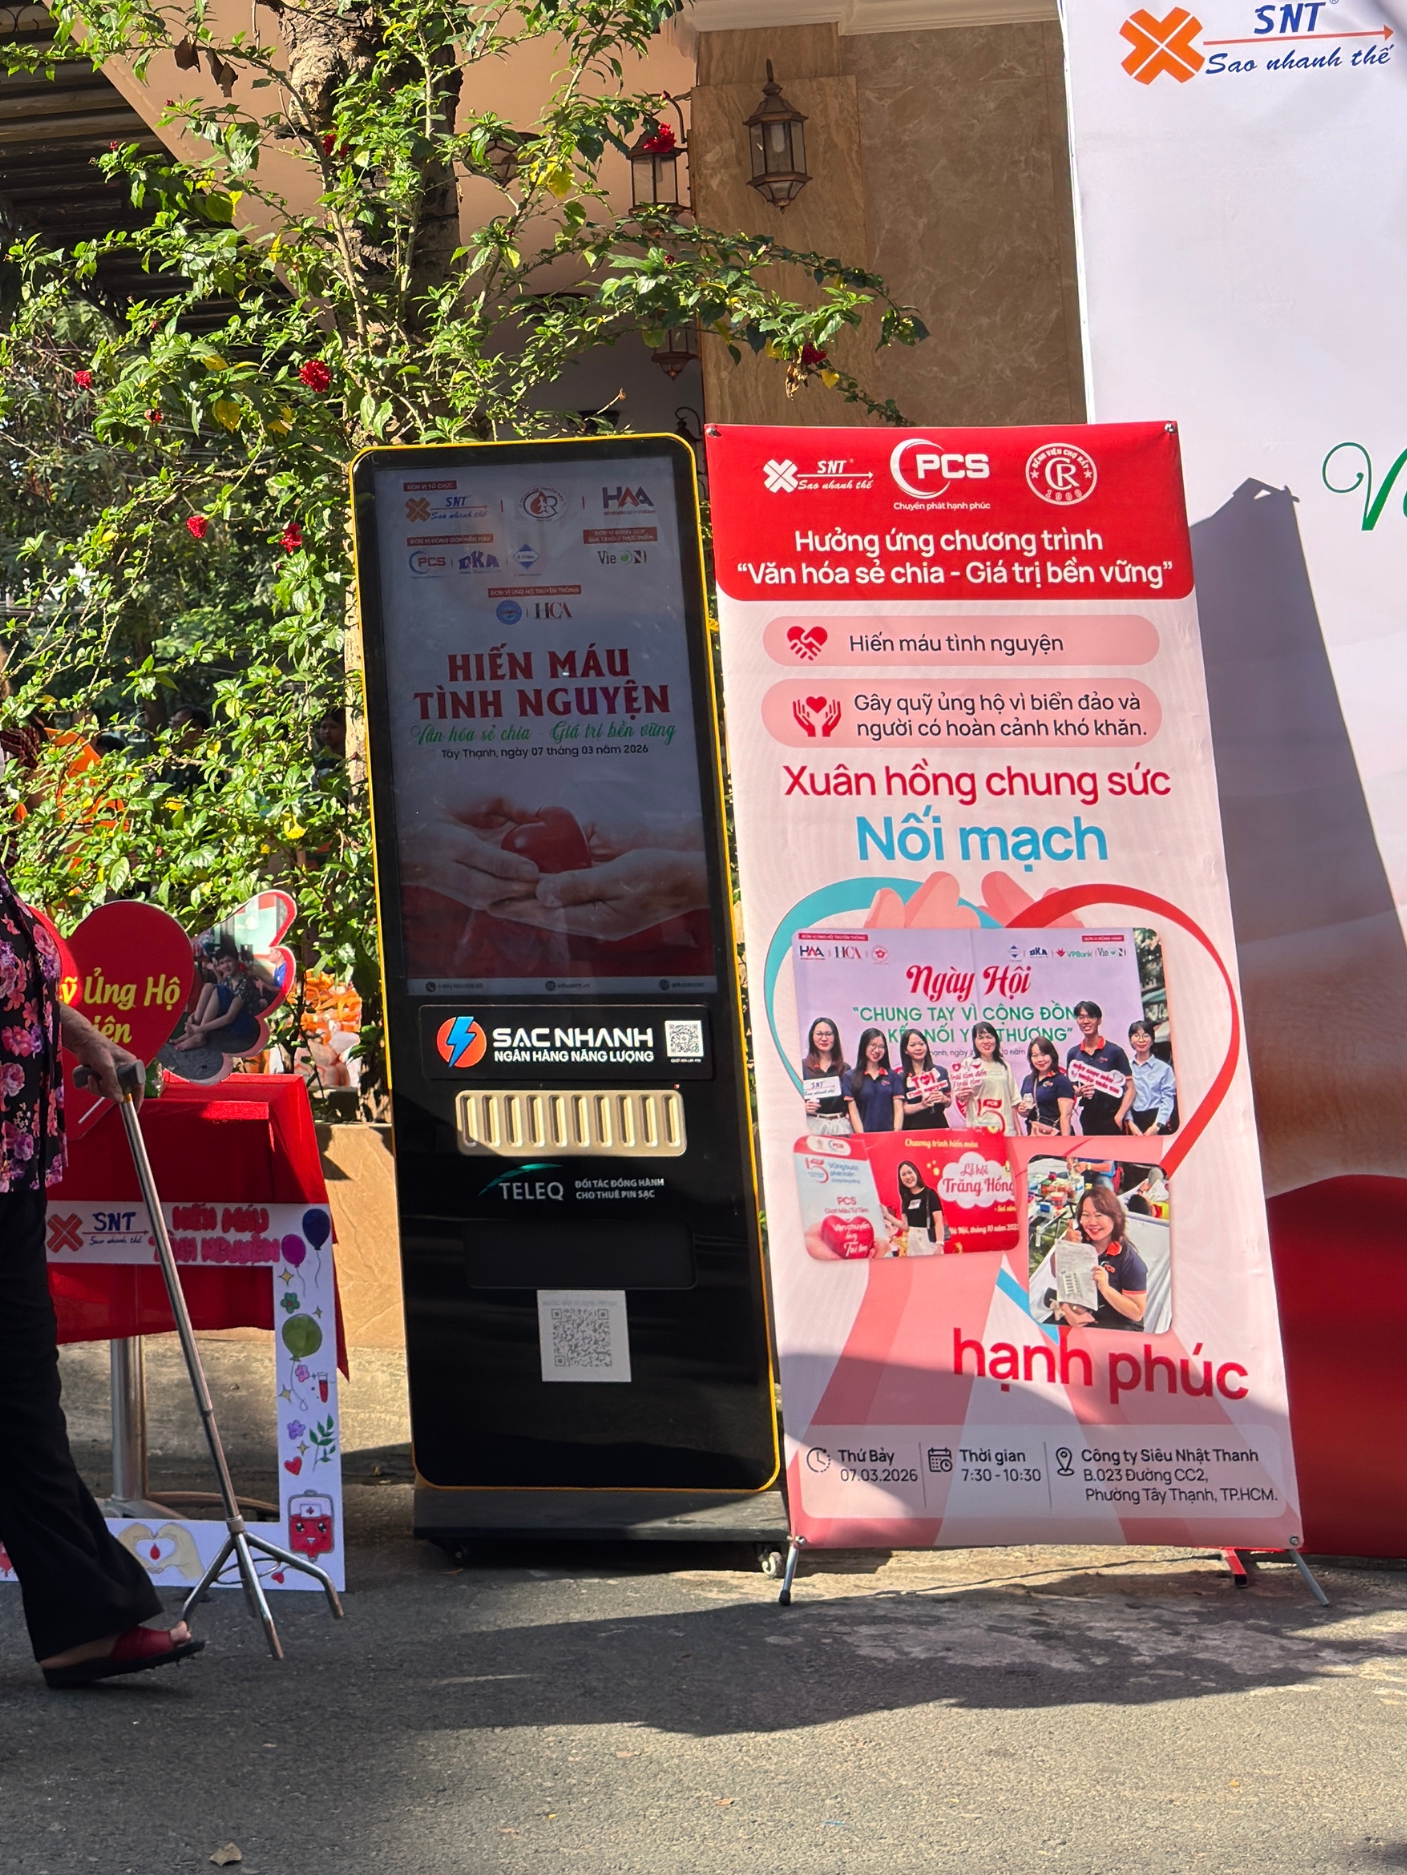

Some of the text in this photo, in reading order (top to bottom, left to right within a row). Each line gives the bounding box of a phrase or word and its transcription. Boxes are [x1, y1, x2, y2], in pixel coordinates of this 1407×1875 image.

[1254, 2, 1326, 34] SNT
[1205, 44, 1395, 75] Sao nhanh thế
[817, 460, 847, 474] SNT
[916, 453, 990, 479] PCS
[798, 479, 874, 490] Sao nhanh thế
[446, 496, 468, 508] SNT
[926, 501, 991, 511] phát hạnh phúc
[795, 527, 1103, 558] Hưởng ứng chương trình
[418, 556, 447, 568] PCS
[801, 560, 850, 584] hóa
[855, 559, 885, 584] sẻ
[890, 561, 945, 584] chia
[966, 559, 1008, 583] Giá
[1012, 561, 1042, 588] trị
[1047, 556, 1095, 583] bền
[850, 632, 1064, 656] Hiến máu tình nguyện
[447, 643, 631, 682] HIẾN MÁU
[413, 679, 671, 721] TÌNH NGUYỆN
[854, 691, 1141, 716] Gây quỹ ủng hộ vì biển đảo và
[448, 724, 475, 743] hóa
[500, 724, 531, 741] chia
[550, 720, 580, 744] Giá
[640, 722, 676, 746] vững
[857, 717, 1147, 741] người có hoàn cảnh khó khăn.
[441, 749, 460, 761] Tây
[500, 747, 528, 759] ngày
[531, 746, 544, 757] 07
[546, 746, 579, 758] tháng
[581, 746, 594, 756] 03
[596, 745, 622, 755] năm
[623, 744, 649, 755] 2026
[782, 758, 1171, 805] Xuân hồng chung sức
[856, 804, 1108, 872] Nối mạch
[84, 967, 180, 1011] Ủng Hộ
[906, 965, 1032, 1002] Ngày Hội
[927, 1007, 955, 1021] TAY
[962, 1003, 978, 1021] VÌ
[983, 1003, 1034, 1025] CỘNG
[1040, 1000, 1076, 1021] ĐỒN
[554, 1027, 653, 1048] NHANH
[924, 1023, 955, 1043] NỐI
[494, 1048, 654, 1065] NGÂN HÀNG NĂNG LƯỢNG
[498, 1182, 564, 1201] TELEQ
[575, 1176, 665, 1189] ĐỐI TÁC ĐỒNG HÀNH
[944, 1177, 983, 1196] Trăng
[575, 1189, 655, 1200] CHO THUÊ PIN SẠC
[837, 1196, 856, 1205] PCS
[93, 1212, 136, 1232] SNT
[953, 1328, 1249, 1404] hạnh phúc
[838, 1447, 895, 1466] Thứ Bảy
[959, 1448, 1026, 1465] Thời gian
[1081, 1448, 1259, 1465] Công ty Siêu Nhật Thanh
[840, 1468, 918, 1481] 07.03.2026
[961, 1468, 1041, 1481] 7:30 10:30
[1084, 1467, 1208, 1484] B.023 Đường CC2,
[1086, 1488, 1140, 1505] Phường
[1142, 1488, 1167, 1505] Tây
[1169, 1488, 1218, 1504] Thạnh,
